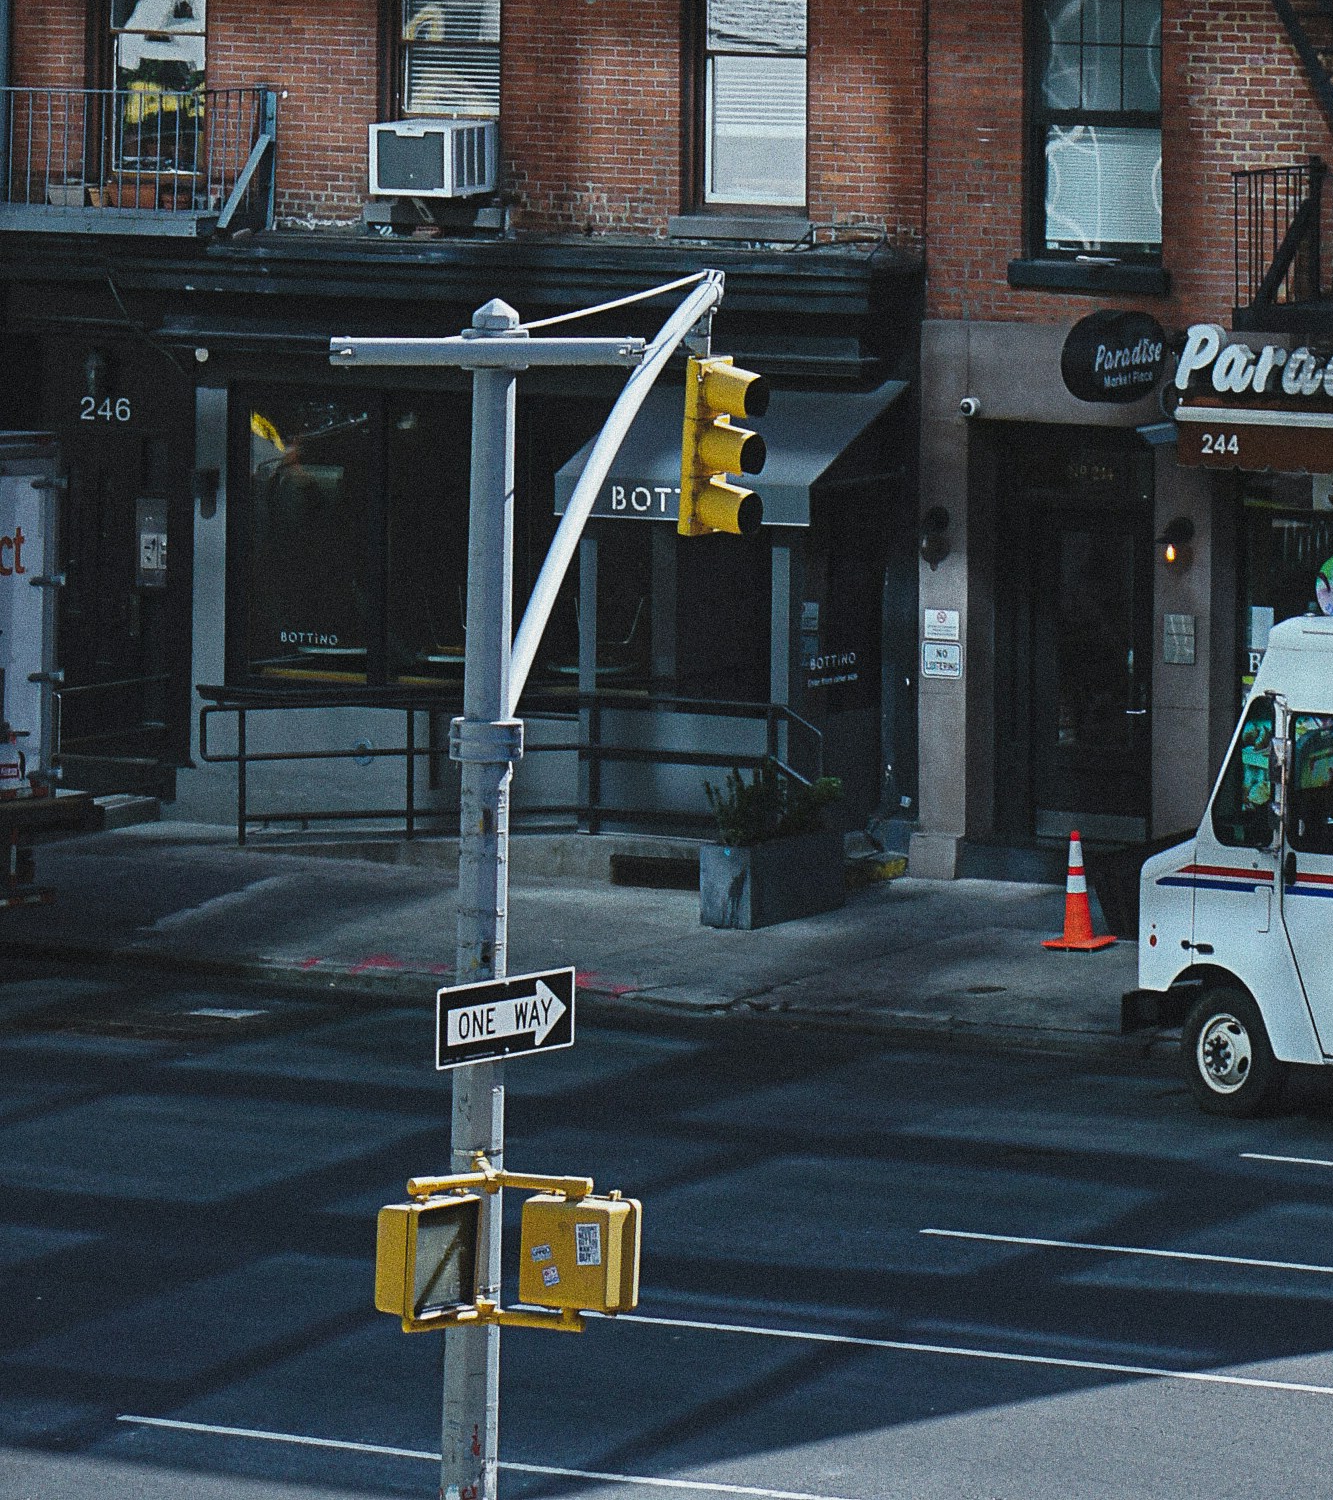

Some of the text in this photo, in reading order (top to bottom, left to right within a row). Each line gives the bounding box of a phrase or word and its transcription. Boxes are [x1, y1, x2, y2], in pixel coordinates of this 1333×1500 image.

[1095, 338, 1162, 372] Paradise
[1104, 371, 1153, 388] Market Place
[80, 397, 131, 421] 246
[1201, 434, 1239, 455] 244
[280, 631, 338, 646] BOTTINO
[810, 652, 856, 671] BOTTINO
[936, 649, 948, 659] NO
[458, 997, 553, 1039] ONE WAY
